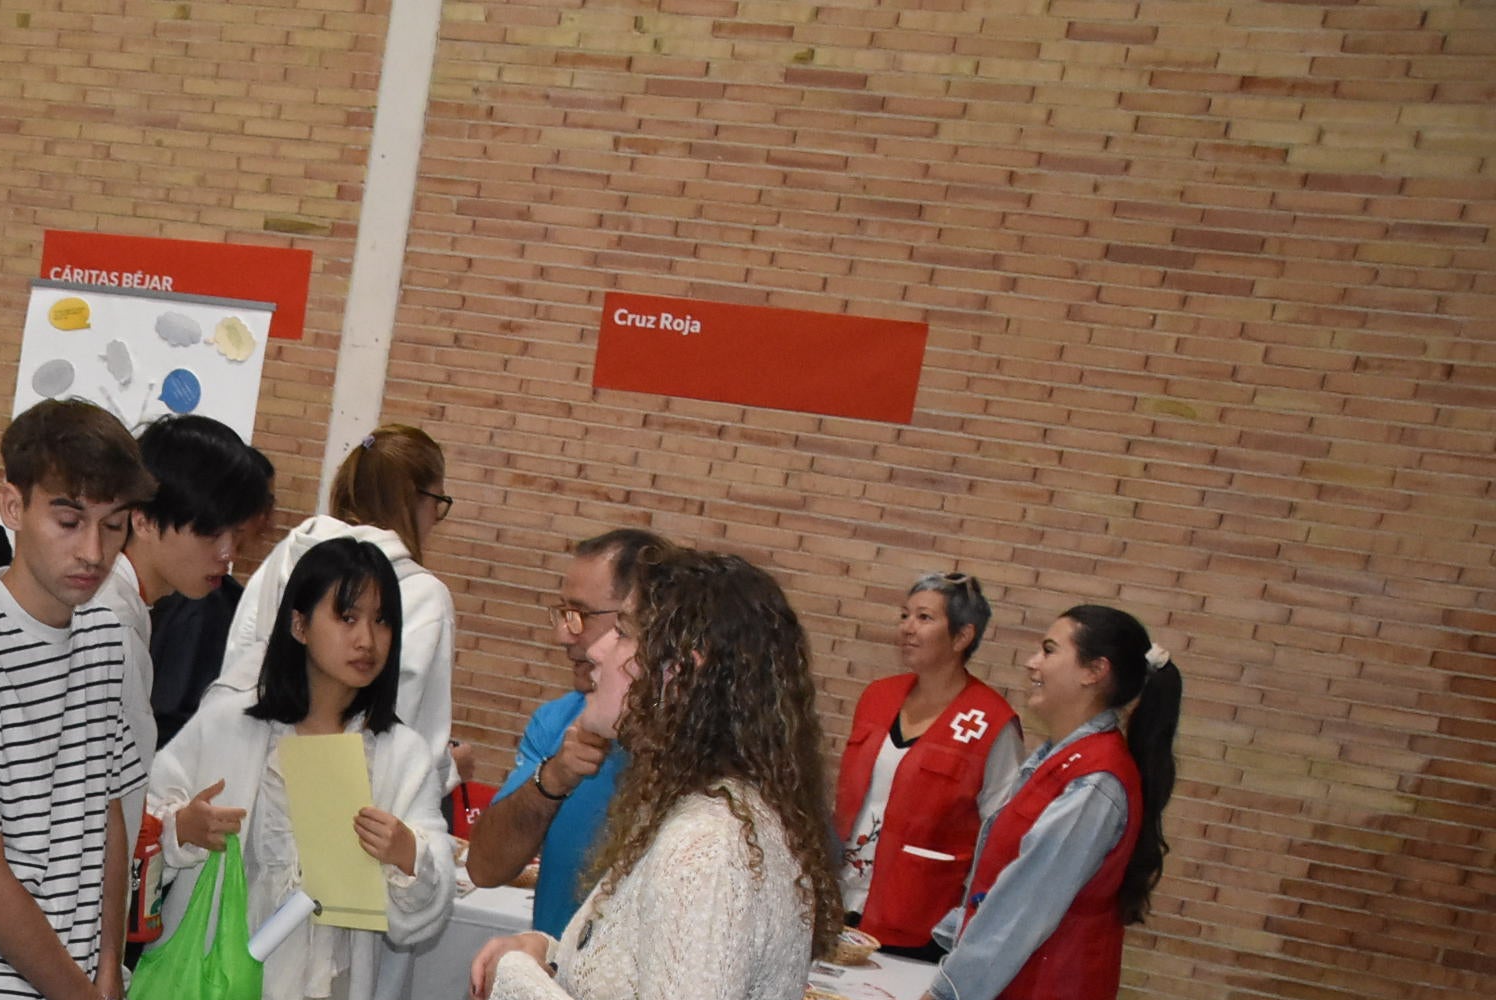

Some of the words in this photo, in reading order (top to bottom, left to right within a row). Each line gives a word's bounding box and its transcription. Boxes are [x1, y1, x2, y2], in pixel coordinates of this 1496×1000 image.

[50, 264, 119, 287] CÁRITAS
[122, 270, 174, 292] BÉJAR
[614, 308, 656, 329] Cruz
[660, 312, 701, 336] Roja
